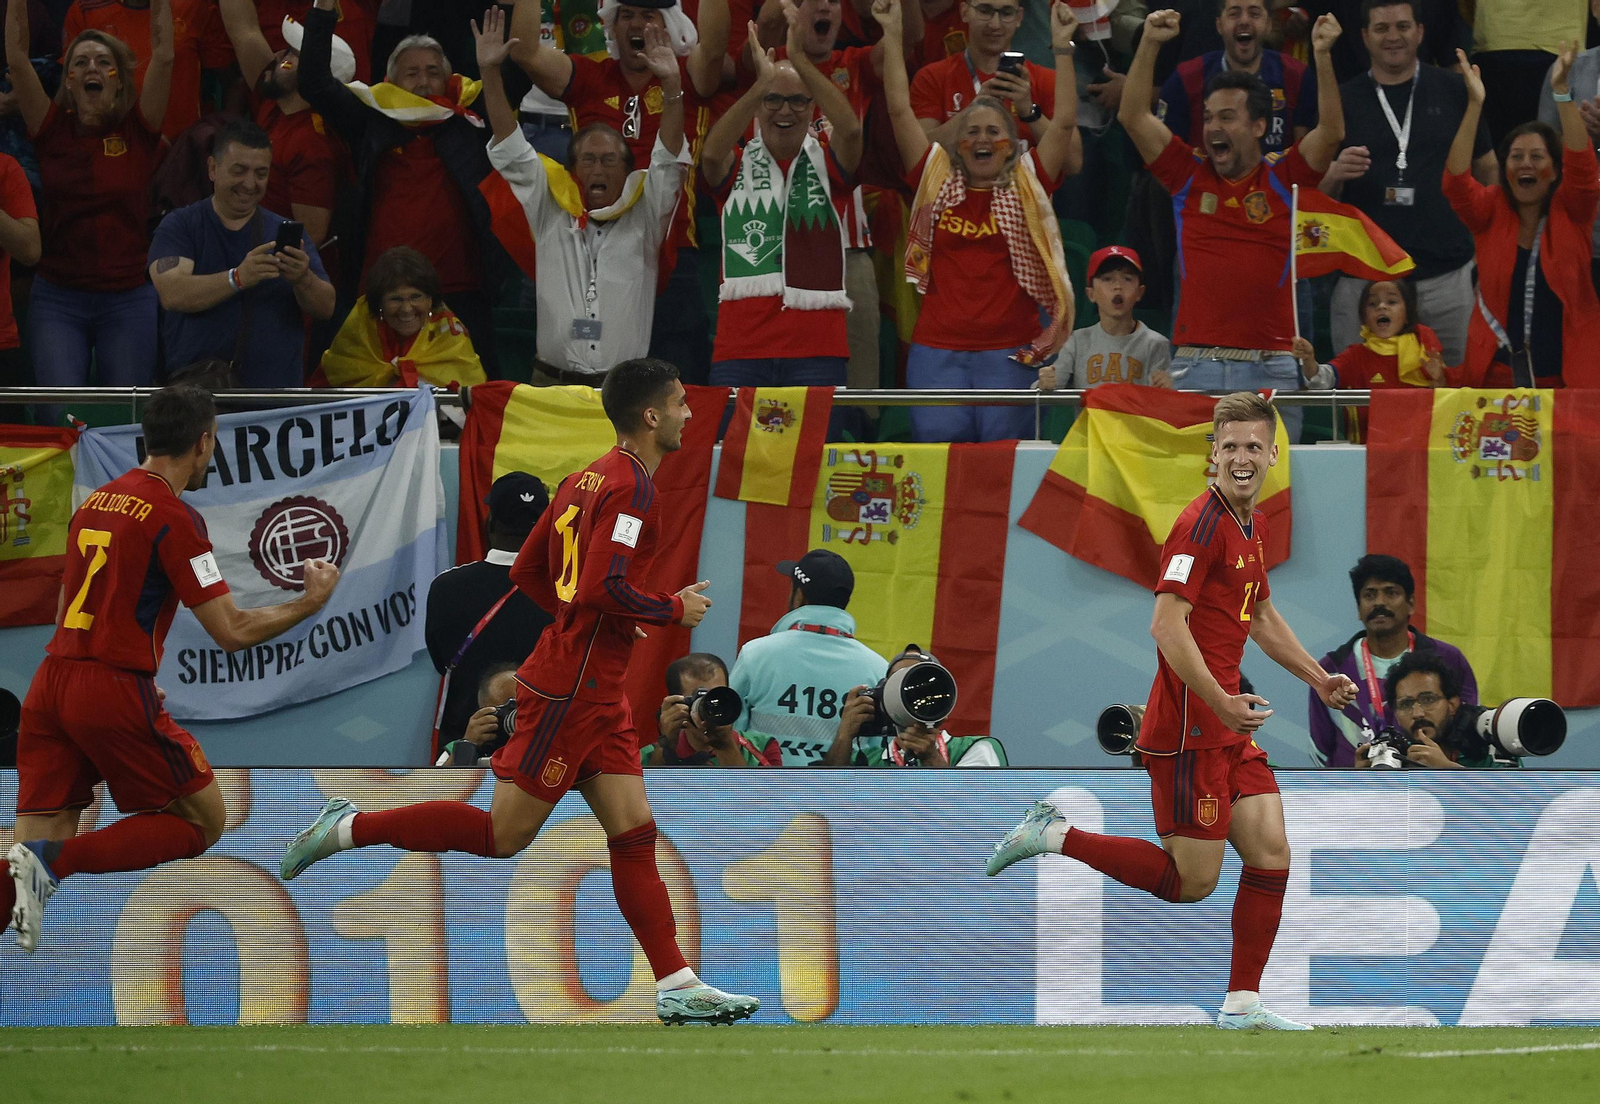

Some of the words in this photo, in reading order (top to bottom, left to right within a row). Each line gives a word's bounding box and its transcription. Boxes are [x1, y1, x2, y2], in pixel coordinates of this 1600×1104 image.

[938, 208, 998, 238] ESPA
[1086, 352, 1144, 385] GAP
[136, 400, 410, 489] ARCELO
[308, 607, 375, 660] CON
[374, 582, 416, 636] VOS
